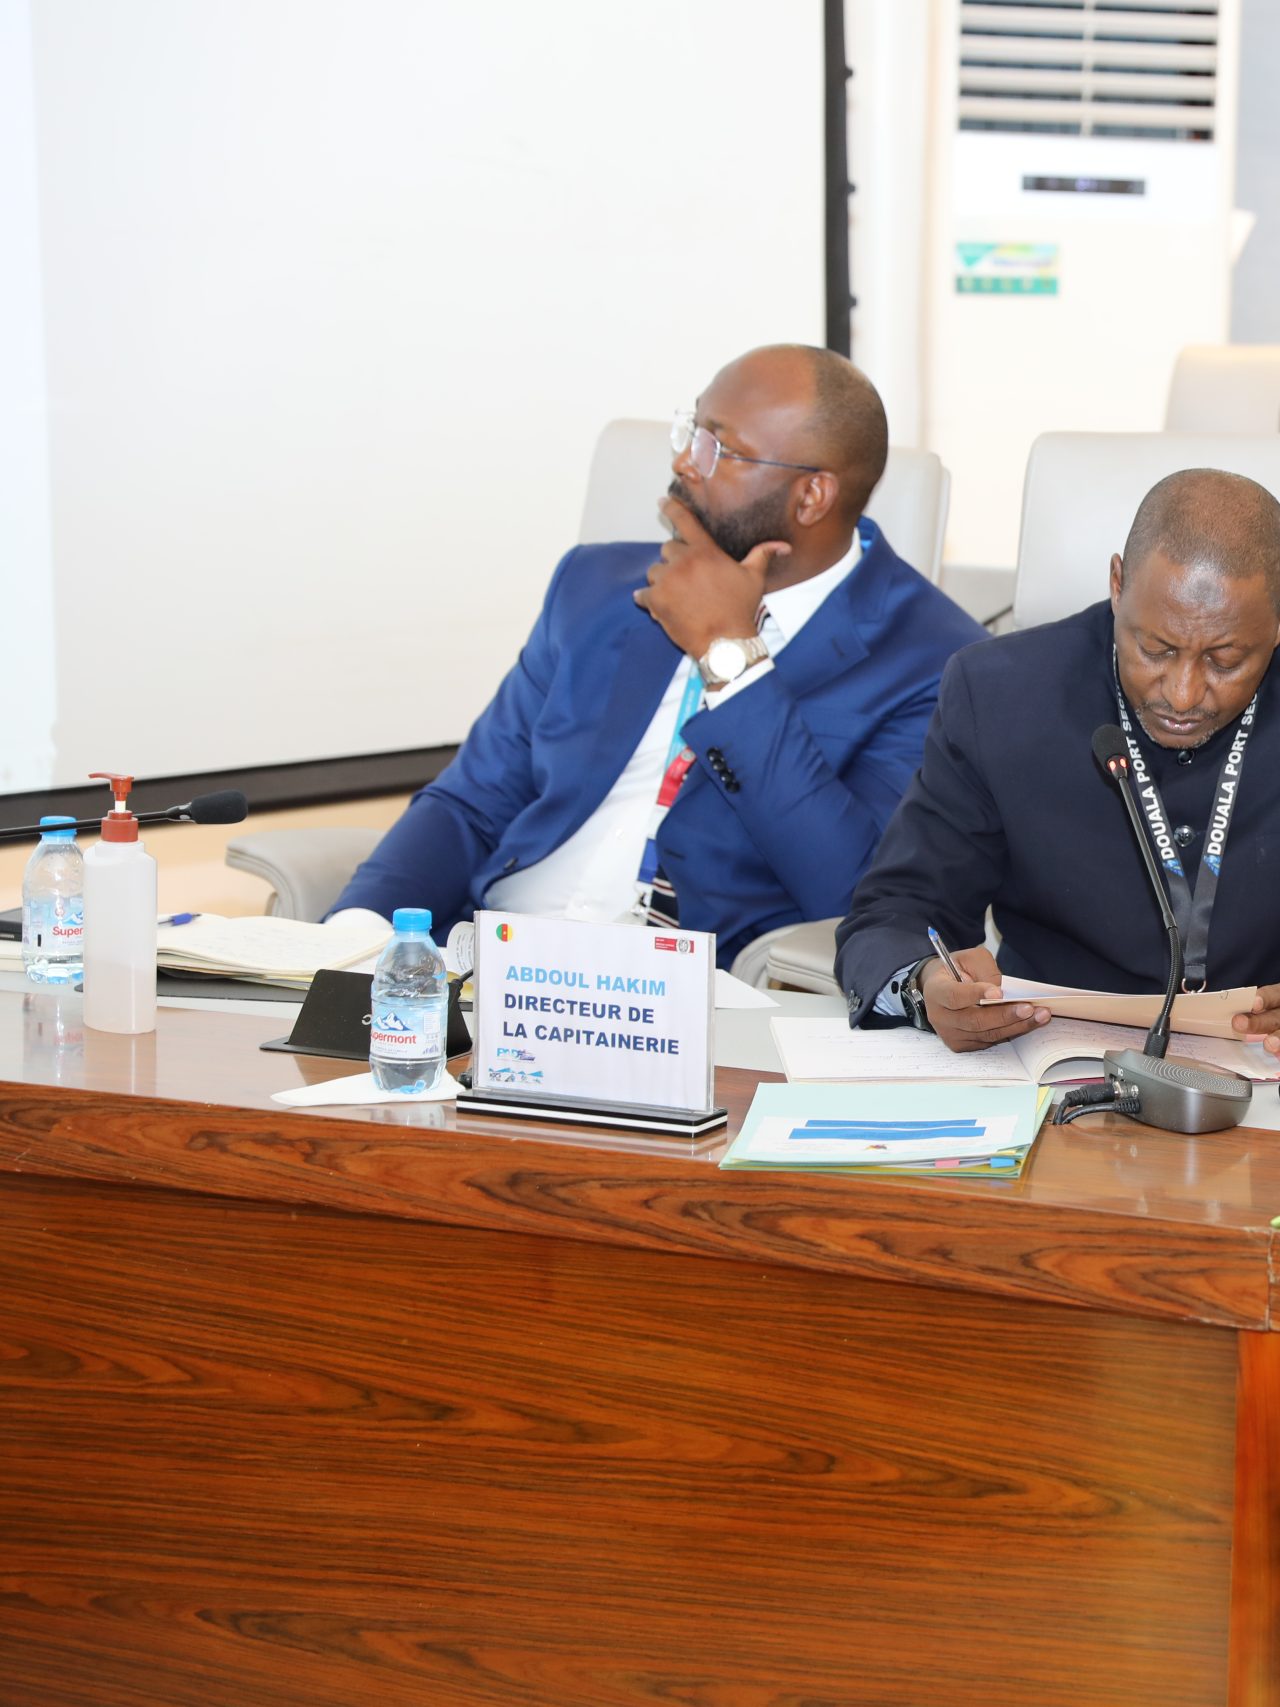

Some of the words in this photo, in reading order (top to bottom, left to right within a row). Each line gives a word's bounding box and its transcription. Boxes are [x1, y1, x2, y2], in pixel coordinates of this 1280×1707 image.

[1126, 736, 1151, 783] PORT
[1207, 781, 1236, 856] DOUALA
[1225, 730, 1249, 776] PORT
[1142, 786, 1175, 860] DOUALA
[505, 965, 590, 989] ABDOUL
[596, 975, 666, 997] HAKIM
[504, 993, 622, 1020] DIRECTEUR
[628, 1006, 655, 1024] DE
[371, 1031, 417, 1045] permont
[503, 1021, 528, 1039] LA
[535, 1024, 680, 1055] CAPITAINERIE
